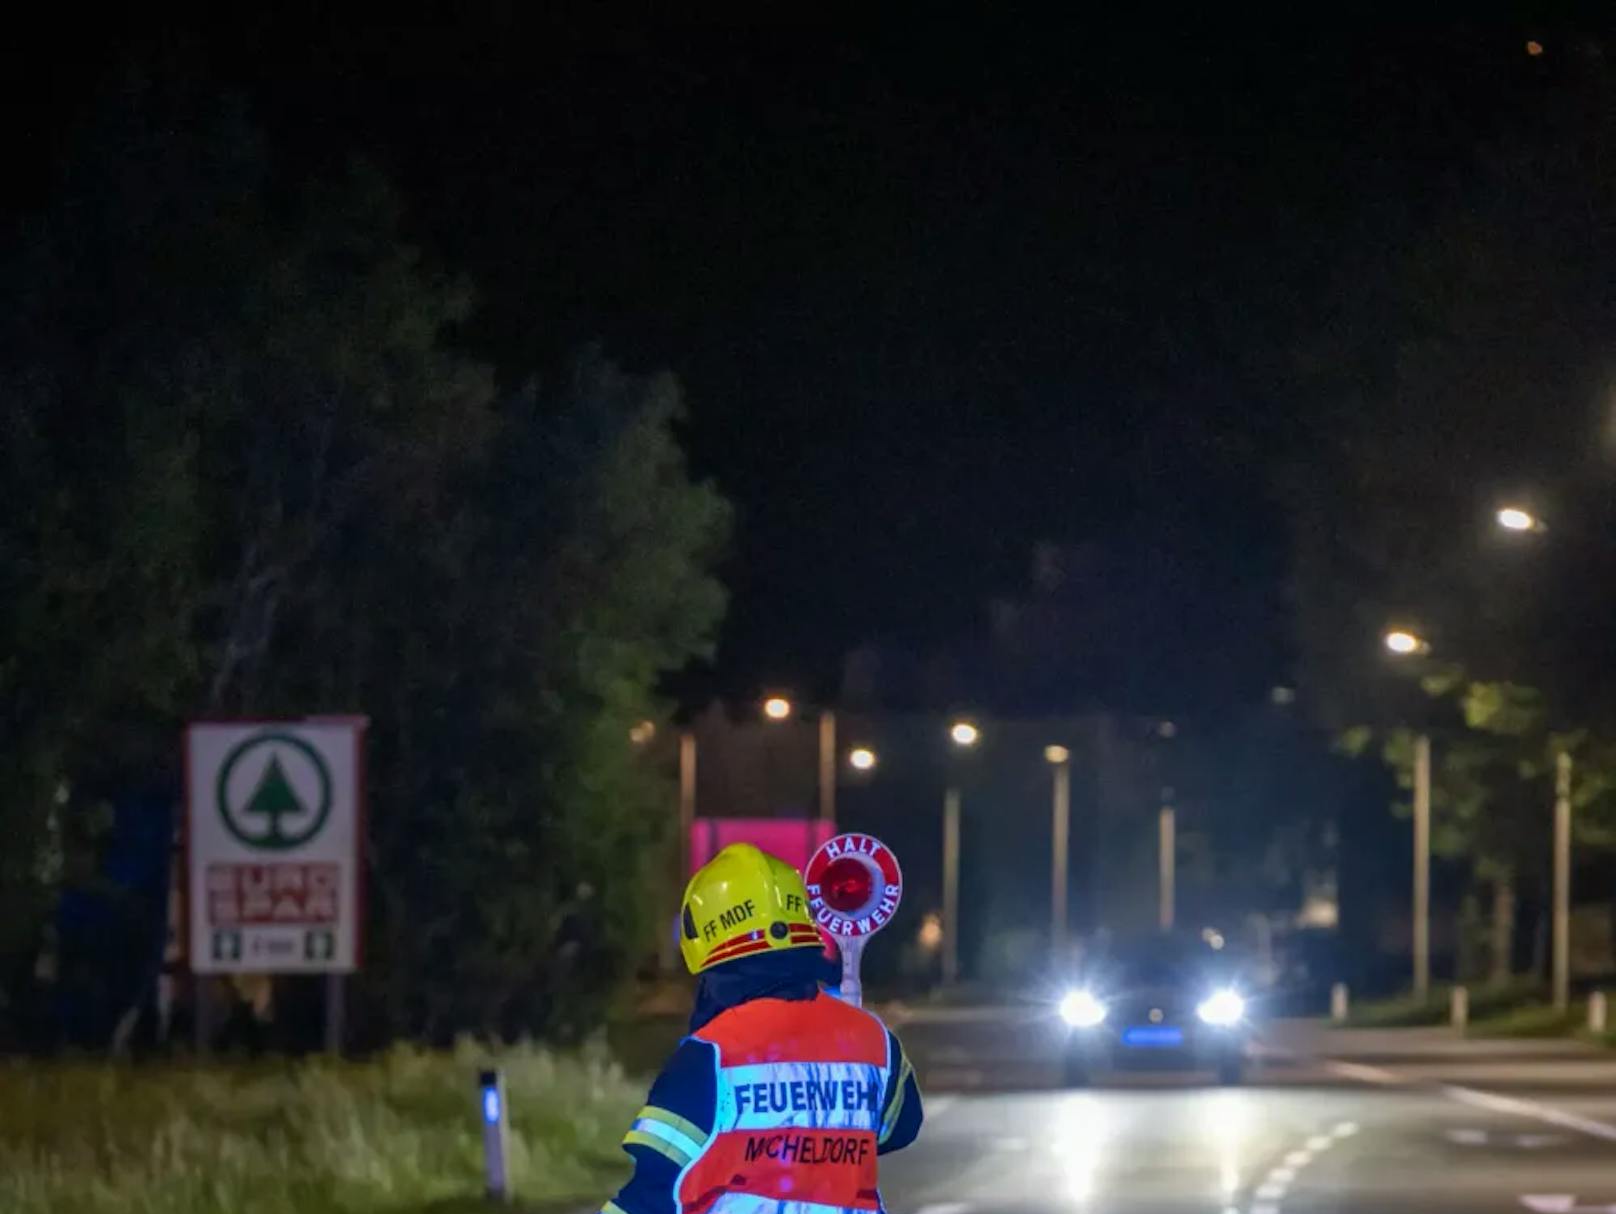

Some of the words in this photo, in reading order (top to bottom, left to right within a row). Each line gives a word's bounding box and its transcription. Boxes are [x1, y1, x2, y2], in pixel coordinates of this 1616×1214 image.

[825, 837, 881, 860] HALT
[787, 893, 802, 912] FF
[807, 883, 899, 936] FEUERWEHR
[703, 918, 718, 942] FF
[719, 899, 756, 930] MDF
[734, 1079, 880, 1114] FEUERWEH
